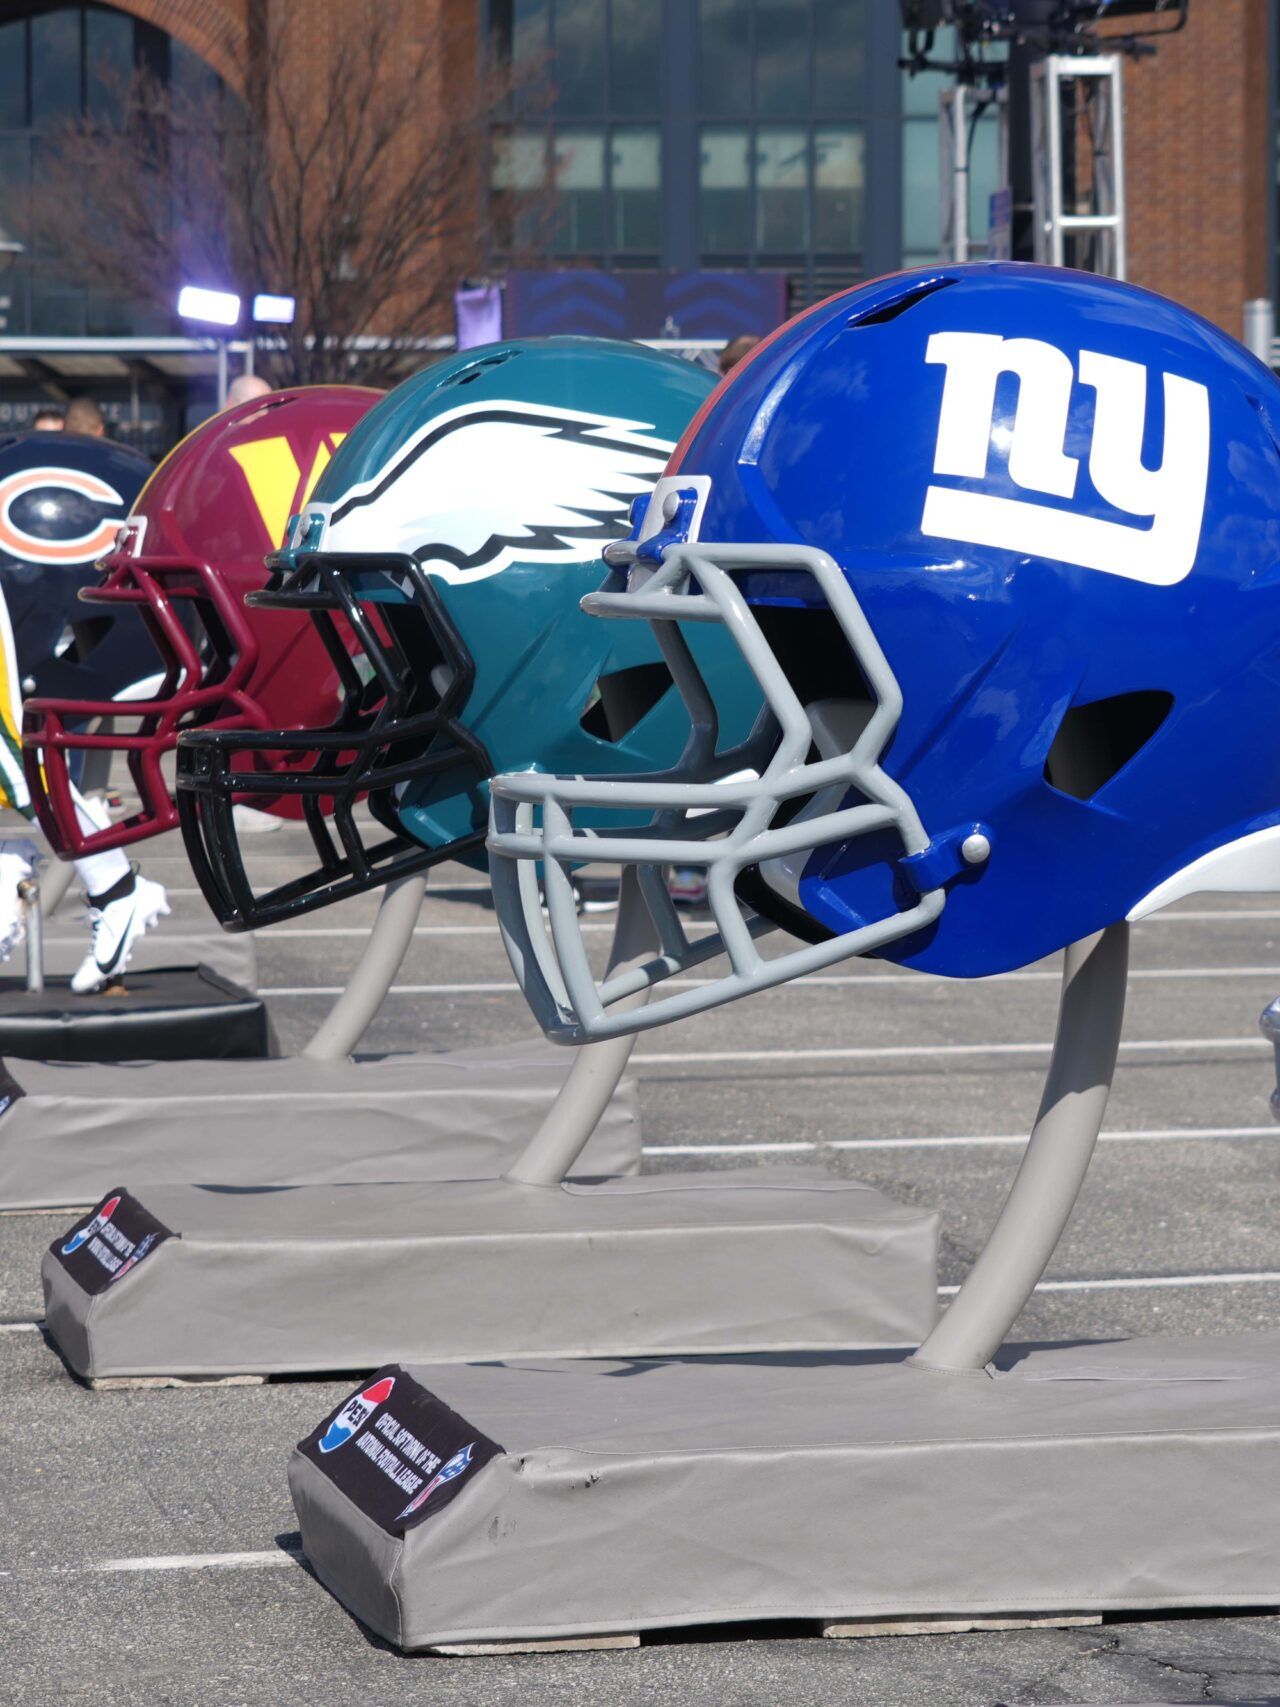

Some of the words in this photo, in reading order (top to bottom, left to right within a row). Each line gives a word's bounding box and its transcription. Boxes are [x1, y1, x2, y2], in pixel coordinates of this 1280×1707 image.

[375, 1412, 400, 1440] OFFICIAL
[392, 1428, 414, 1450] SOFT
[402, 1438, 426, 1461] DRINK
[355, 1431, 385, 1462] NATIONAL
[375, 1448, 404, 1479] FOOTBALL
[394, 1467, 423, 1494] LEAGUE
[415, 1448, 431, 1466] OF
[421, 1452, 441, 1474] THE
